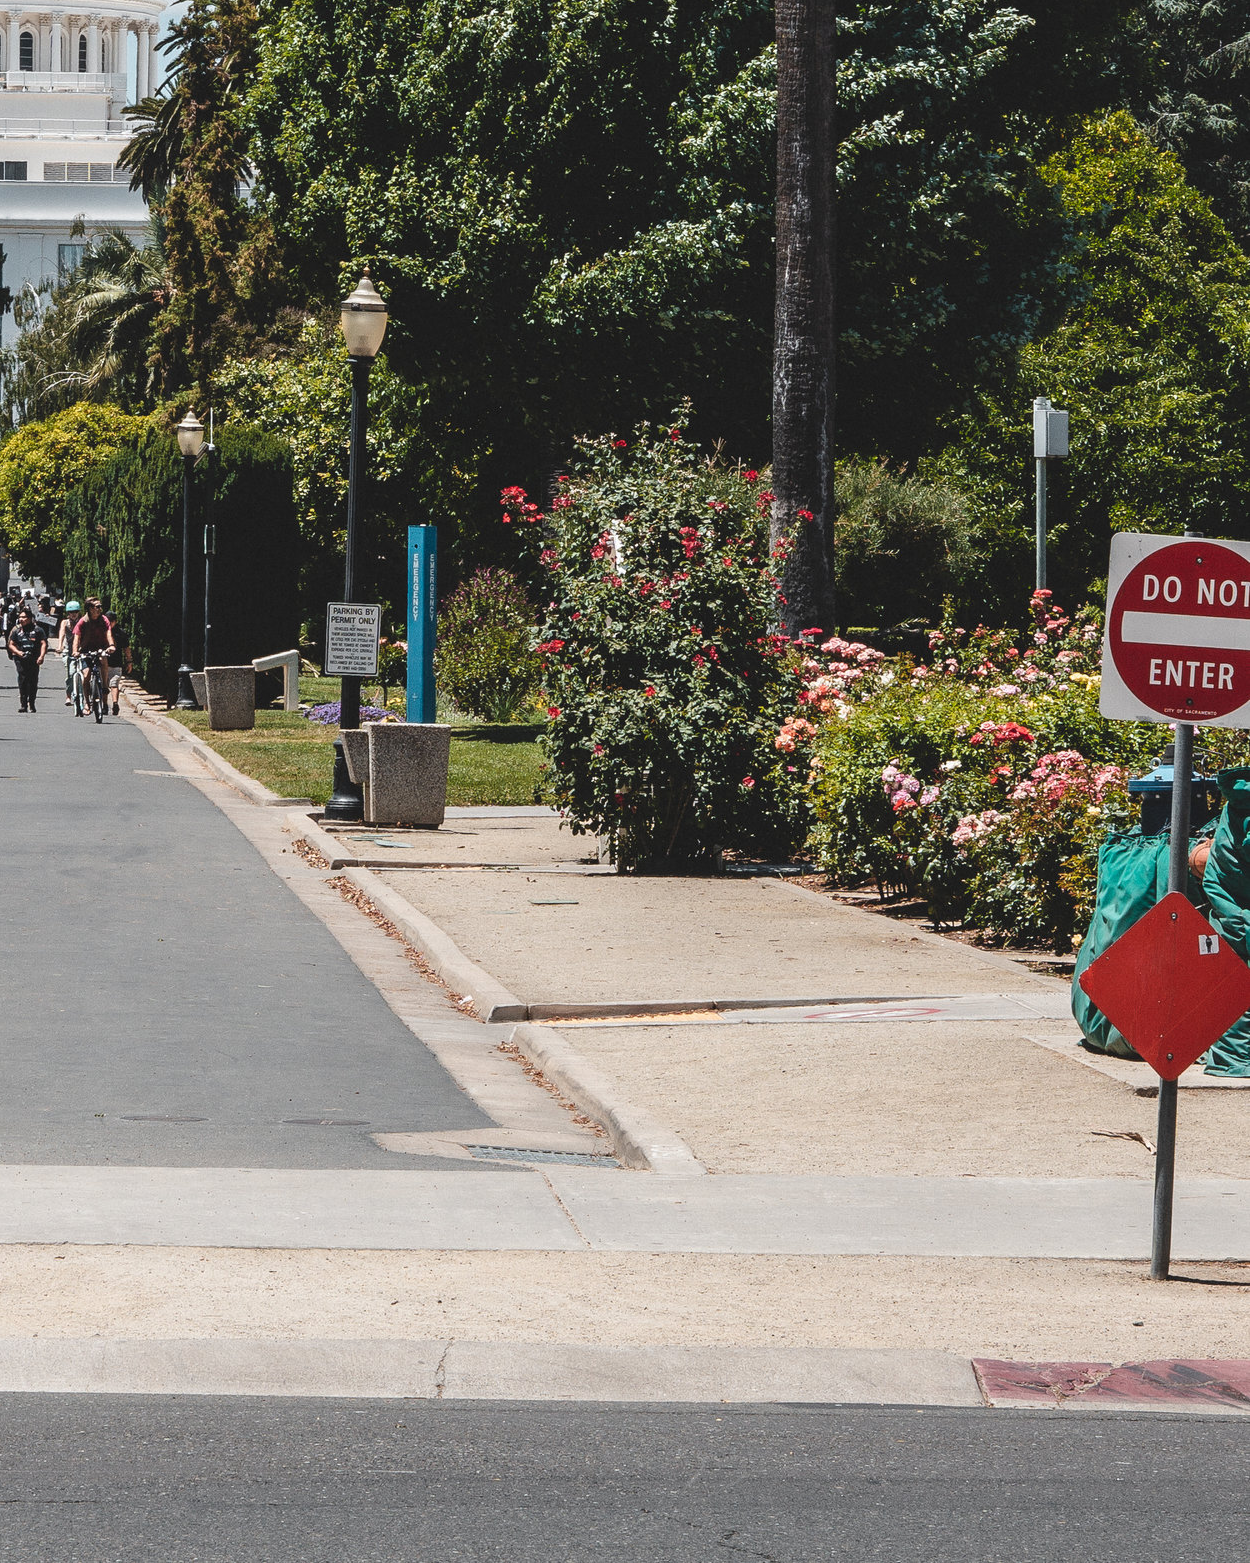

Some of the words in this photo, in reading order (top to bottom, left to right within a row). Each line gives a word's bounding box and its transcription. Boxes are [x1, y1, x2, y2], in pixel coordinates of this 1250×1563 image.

[1142, 574, 1182, 603] DO
[1197, 578, 1250, 607] NOT
[331, 616, 356, 624] PERMIT
[358, 617, 376, 625] ONLY
[333, 607, 362, 615] PARKING
[1149, 658, 1235, 690] ENTER
